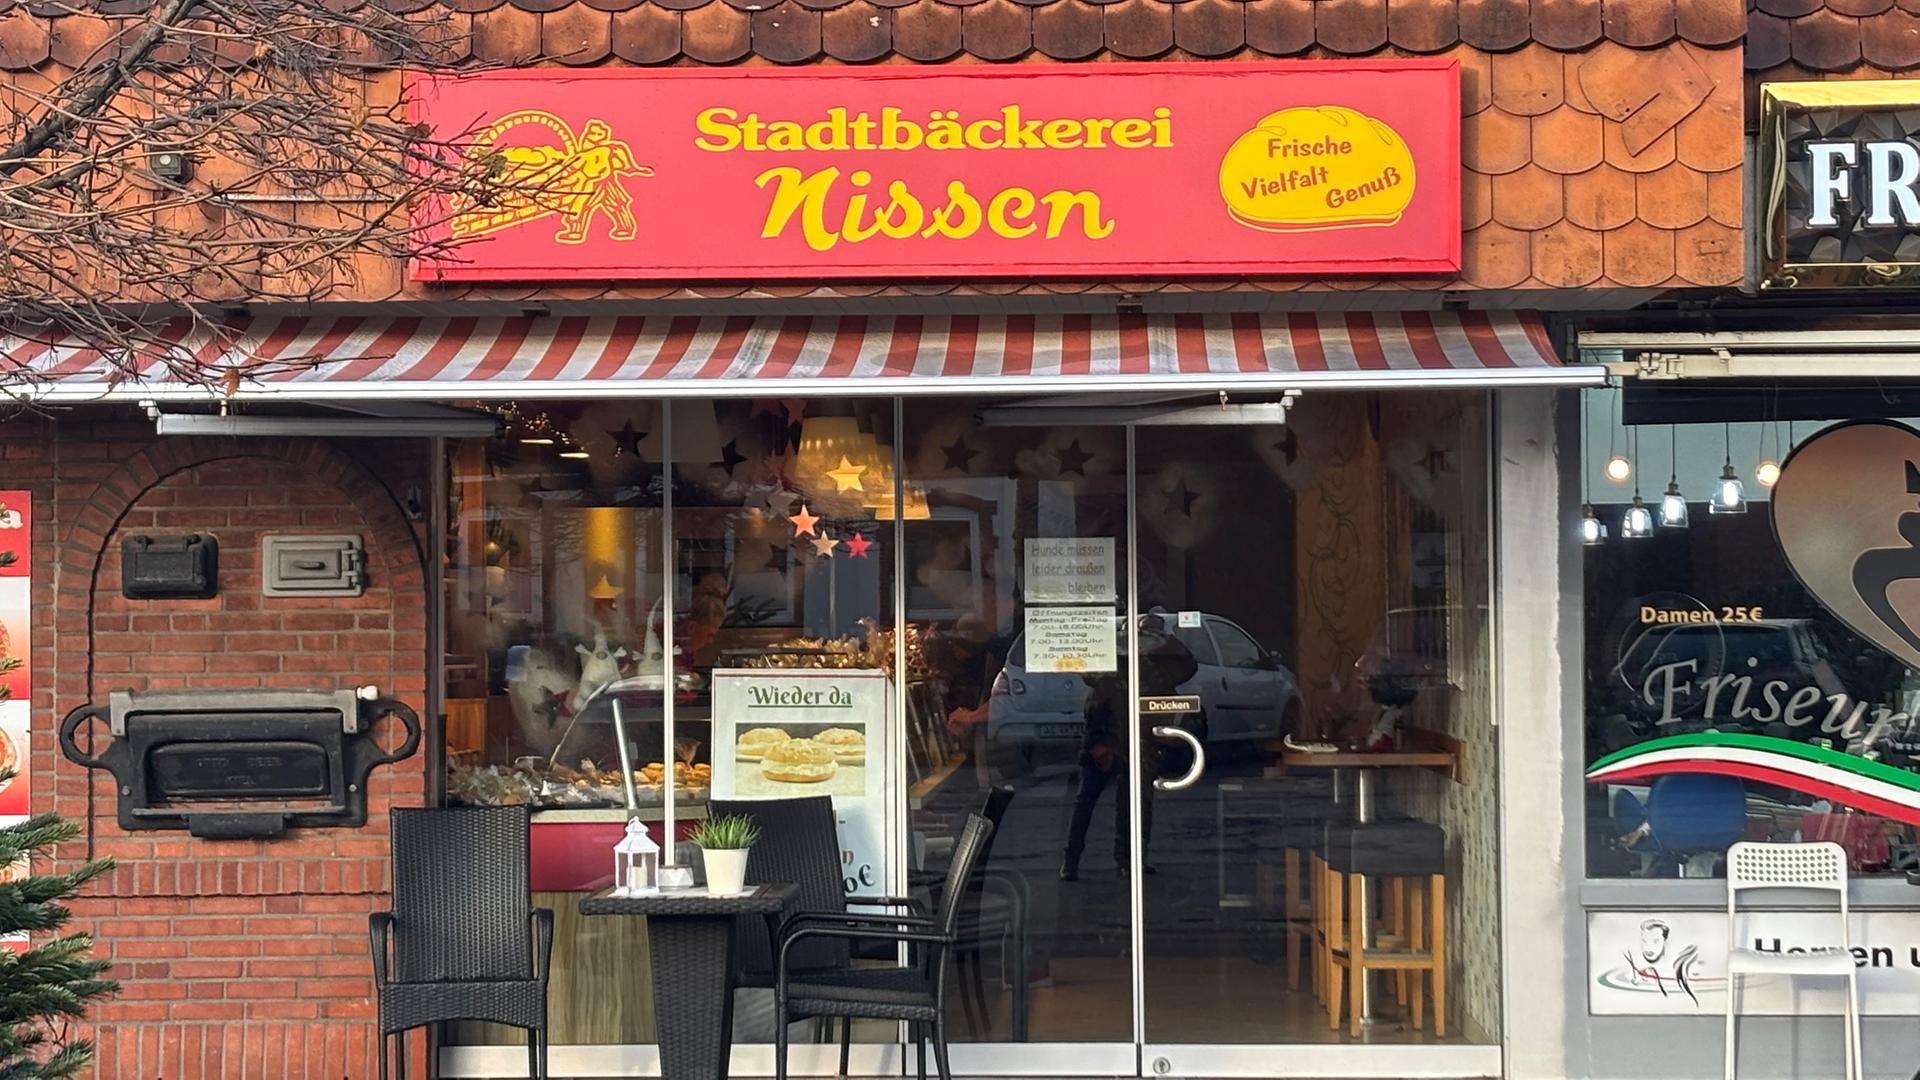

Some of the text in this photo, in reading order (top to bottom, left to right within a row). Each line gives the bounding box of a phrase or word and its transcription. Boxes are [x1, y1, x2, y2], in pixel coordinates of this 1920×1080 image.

[695, 104, 1174, 152] Stadtbäckerei
[1267, 135, 1352, 158] Frische
[1240, 166, 1329, 199] Vielfalt
[1325, 166, 1401, 209] Genuß
[753, 165, 1116, 251] Nissen
[1031, 543, 1105, 554] Hunde müssen
[1031, 561, 1105, 575] leider draußen
[1068, 581, 1106, 594] bleiben
[1640, 606, 1763, 623] Damen 25€
[748, 686, 853, 705] Wieder da
[1149, 701, 1190, 711] Drücken
[1643, 656, 1908, 747] Friseur
[1755, 938, 1893, 967] Hen
